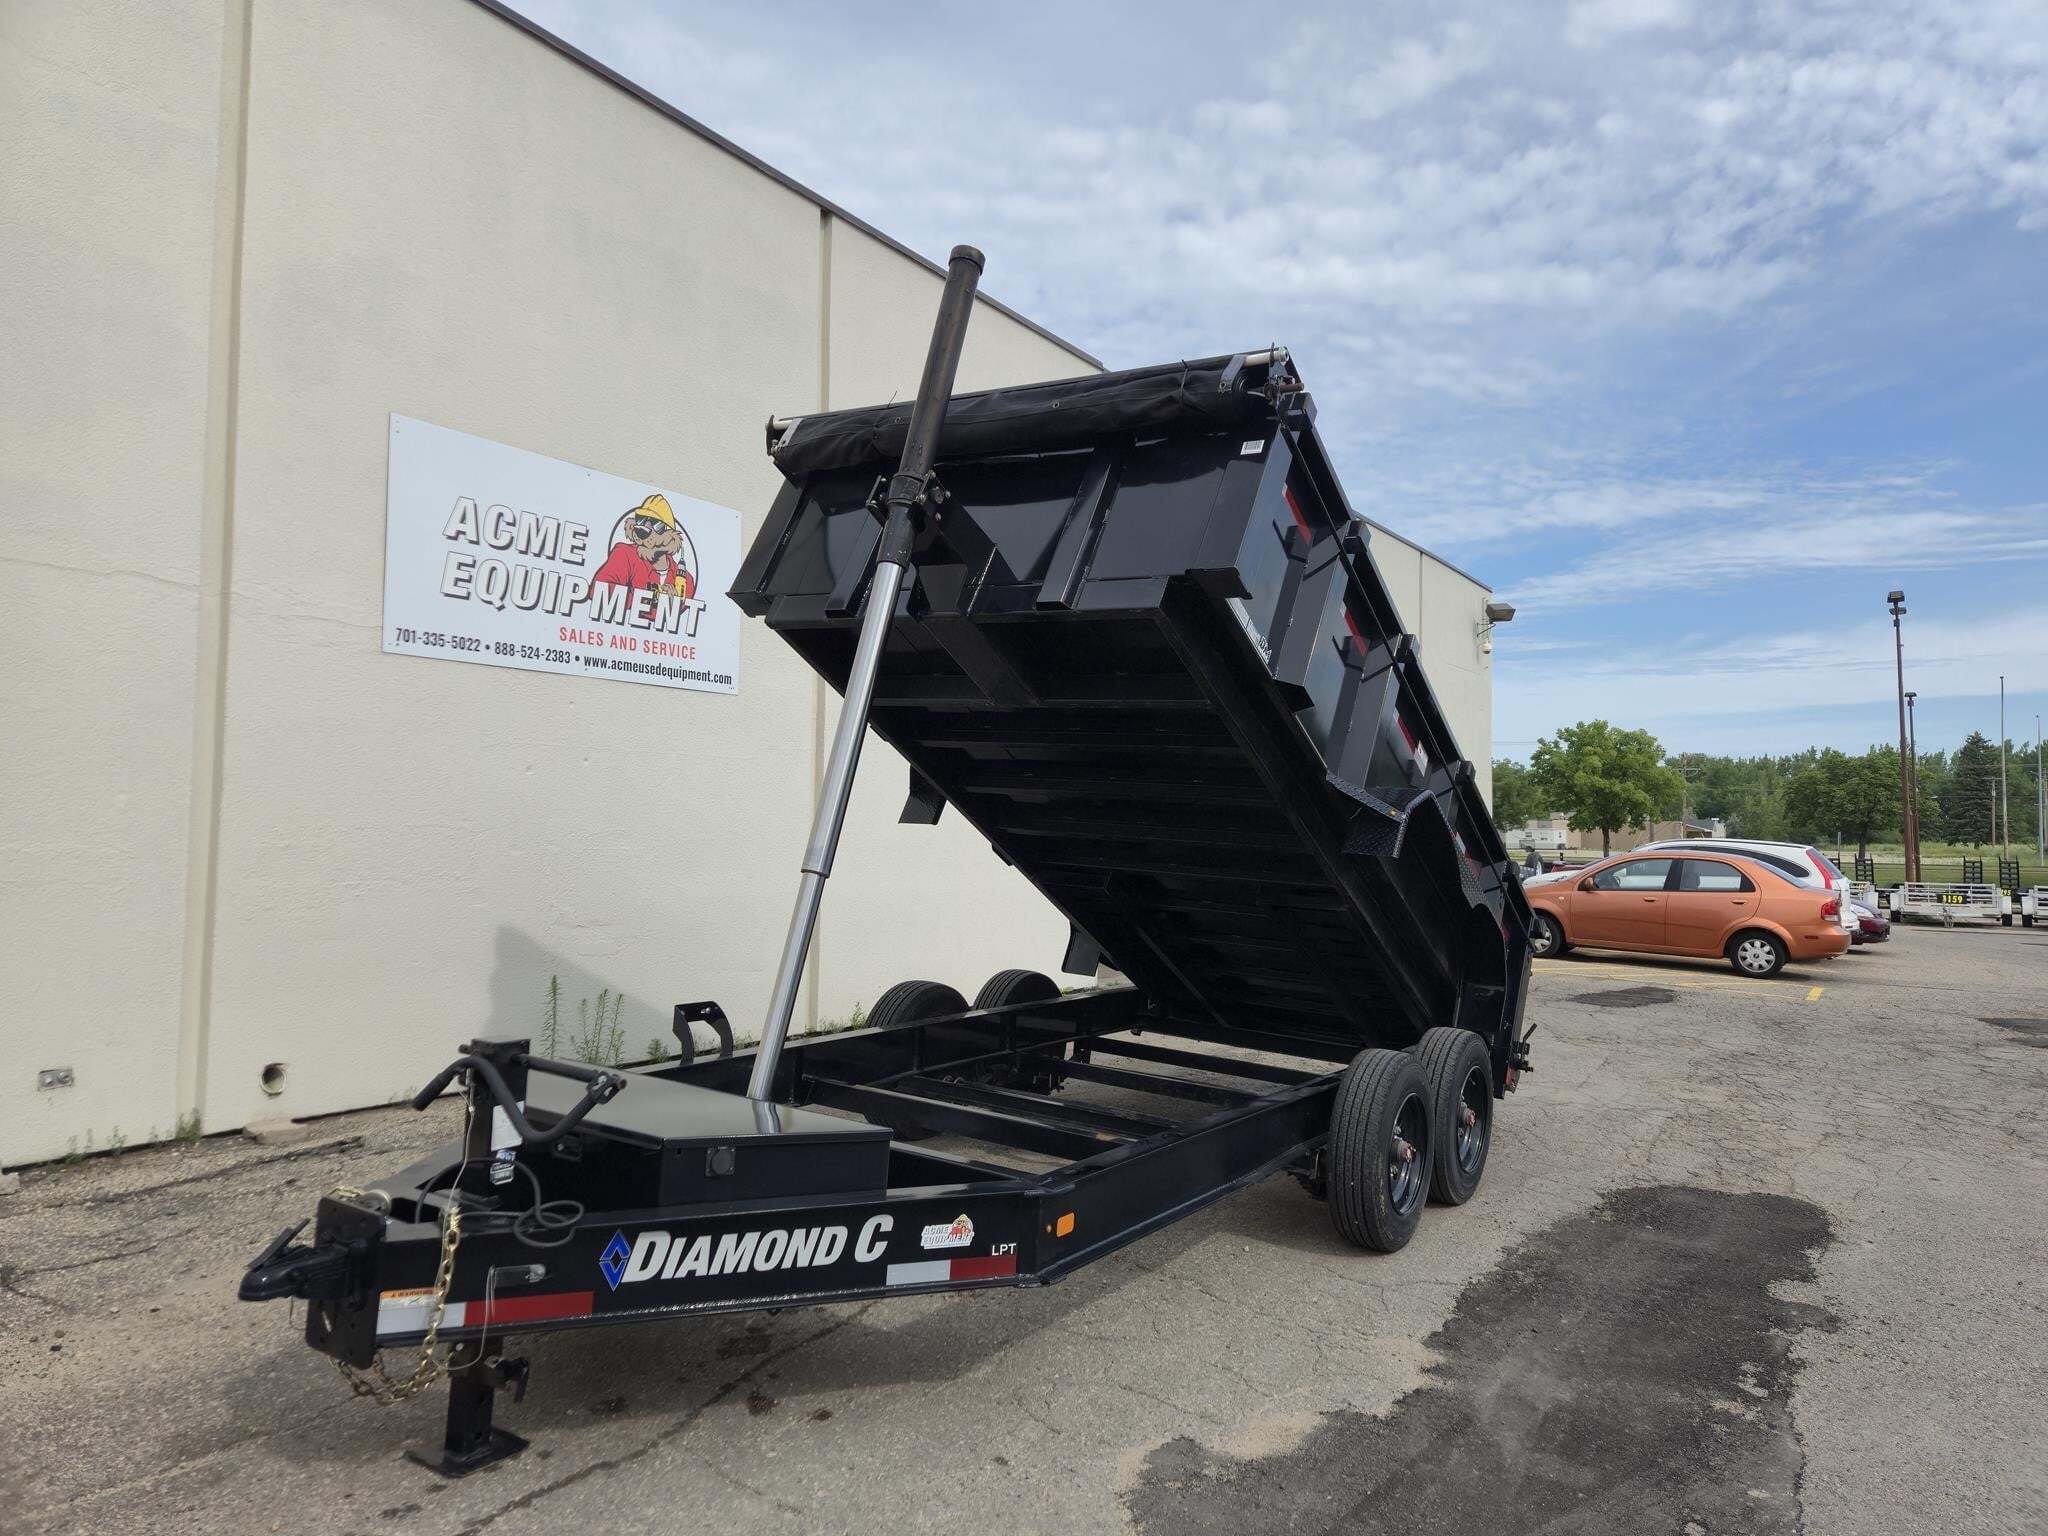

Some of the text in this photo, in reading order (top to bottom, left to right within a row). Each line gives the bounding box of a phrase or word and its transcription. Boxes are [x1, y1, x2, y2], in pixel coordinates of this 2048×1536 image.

[442, 496, 590, 566] ACME
[440, 551, 707, 638] EQUIPMENT
[395, 627, 732, 685] 701-335-5022 888-524-2383 www.acmeusedequipment.com
[559, 626, 697, 661] SALES AND SERVICE
[621, 1214, 894, 1283] DIAMOND C
[991, 1243, 1017, 1256] LPT
